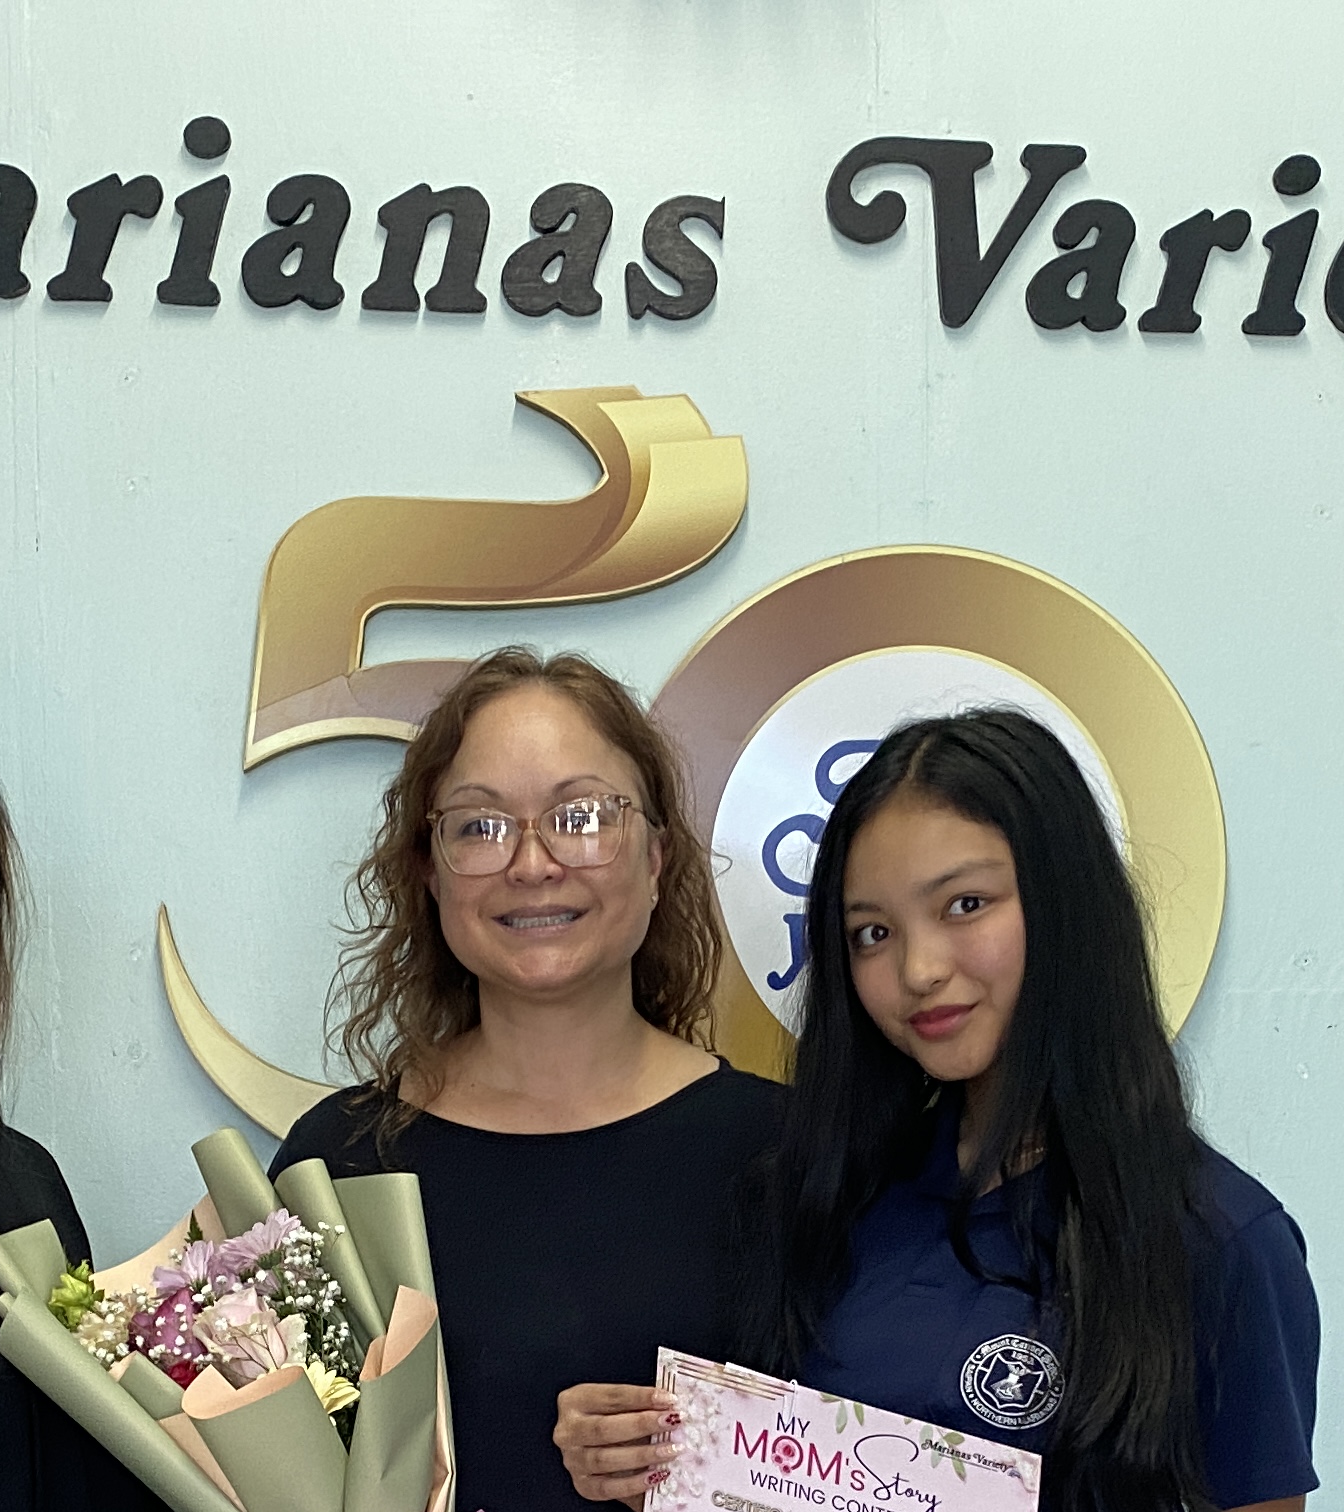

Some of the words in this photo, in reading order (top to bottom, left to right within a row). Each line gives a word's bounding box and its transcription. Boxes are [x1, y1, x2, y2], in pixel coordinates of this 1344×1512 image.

[776, 1413, 810, 1438] MY
[921, 1439, 972, 1462] Marianas
[750, 1469, 826, 1505] WRITING
